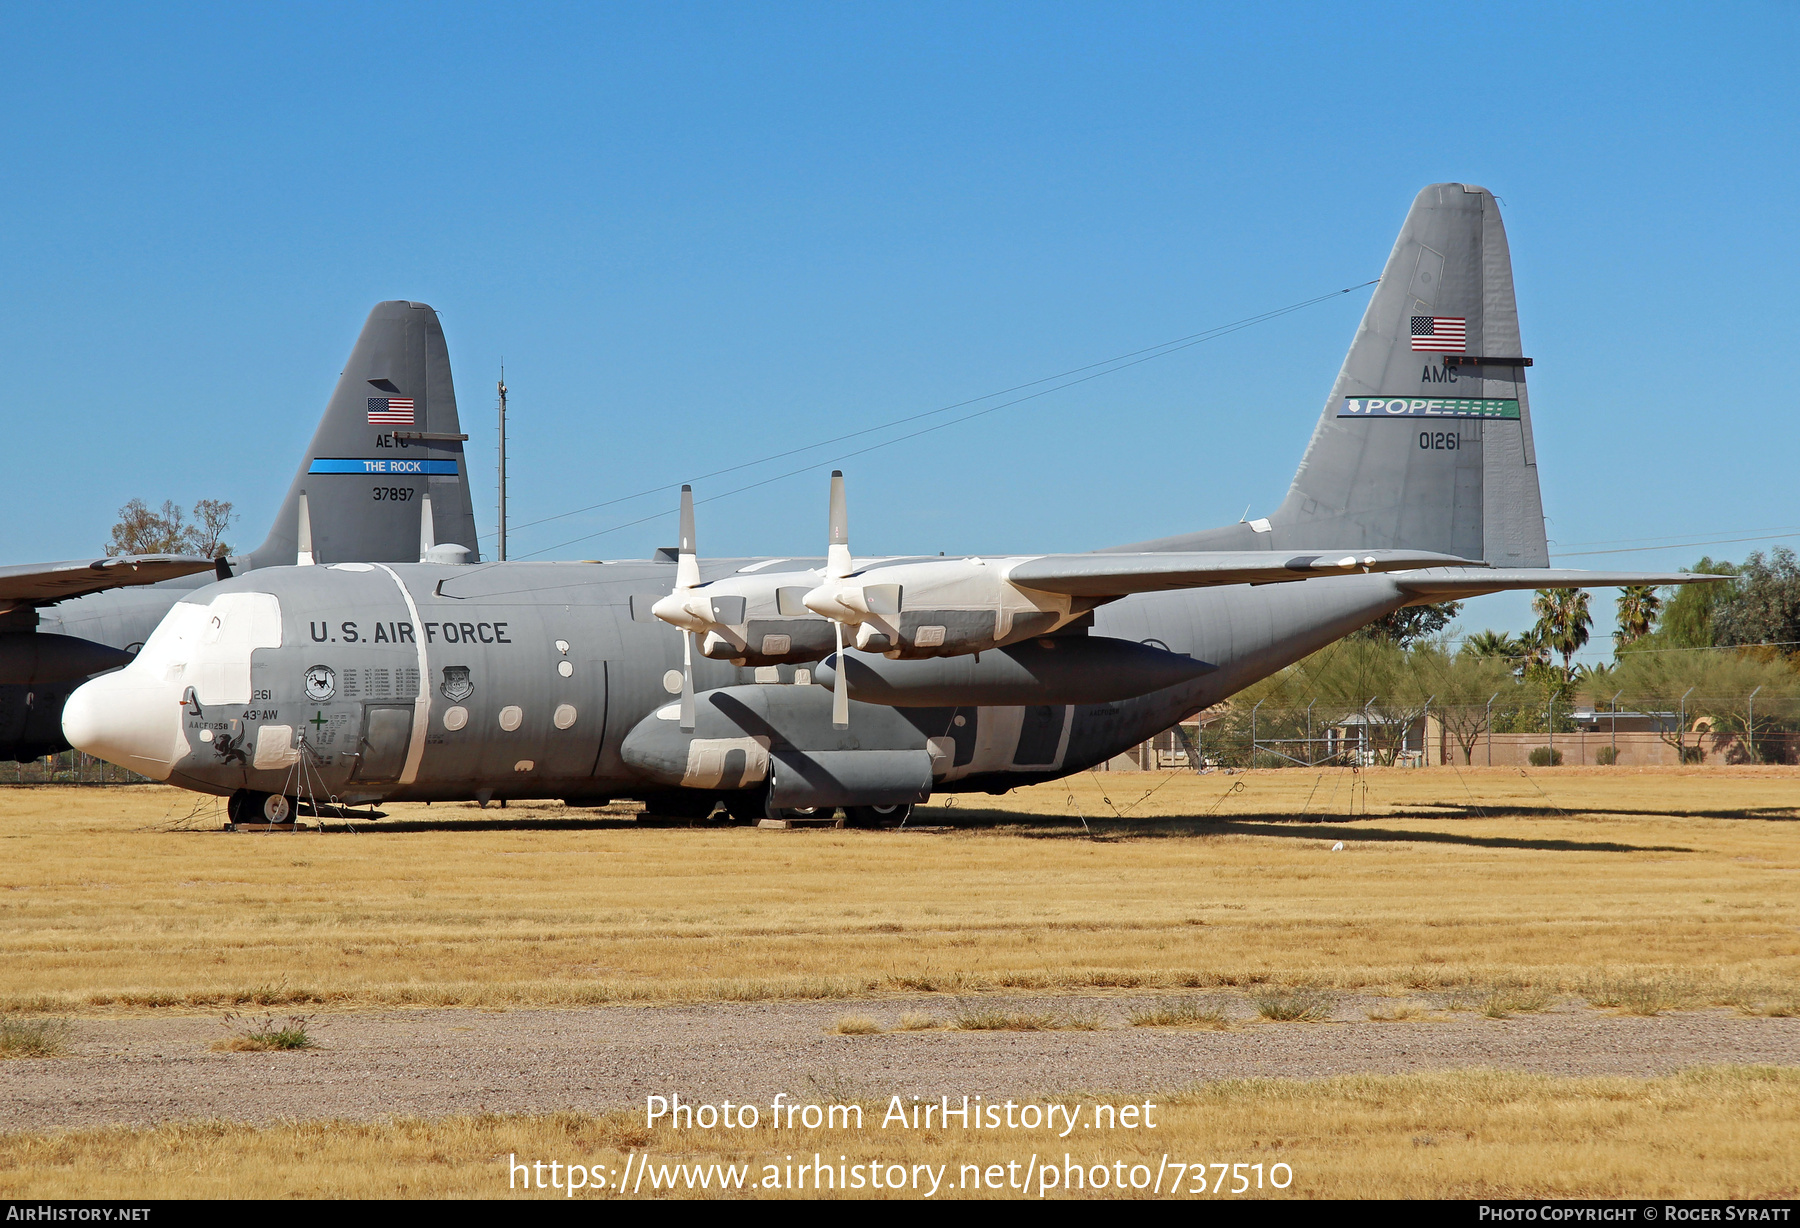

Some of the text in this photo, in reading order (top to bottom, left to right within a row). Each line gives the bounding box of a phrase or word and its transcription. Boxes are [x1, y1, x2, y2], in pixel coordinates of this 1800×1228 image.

[1422, 365, 1458, 383] AMC
[1365, 399, 1444, 415] POPE
[1419, 432, 1460, 450] 01261
[363, 461, 421, 472] THE ROCK
[372, 487, 414, 501] 37897
[310, 621, 512, 644] U.S. AIR FORCE
[254, 689, 271, 700] 261
[262, 710, 278, 720] AW
[189, 721, 228, 730] AACF0258
[229, 719, 238, 730] 7
